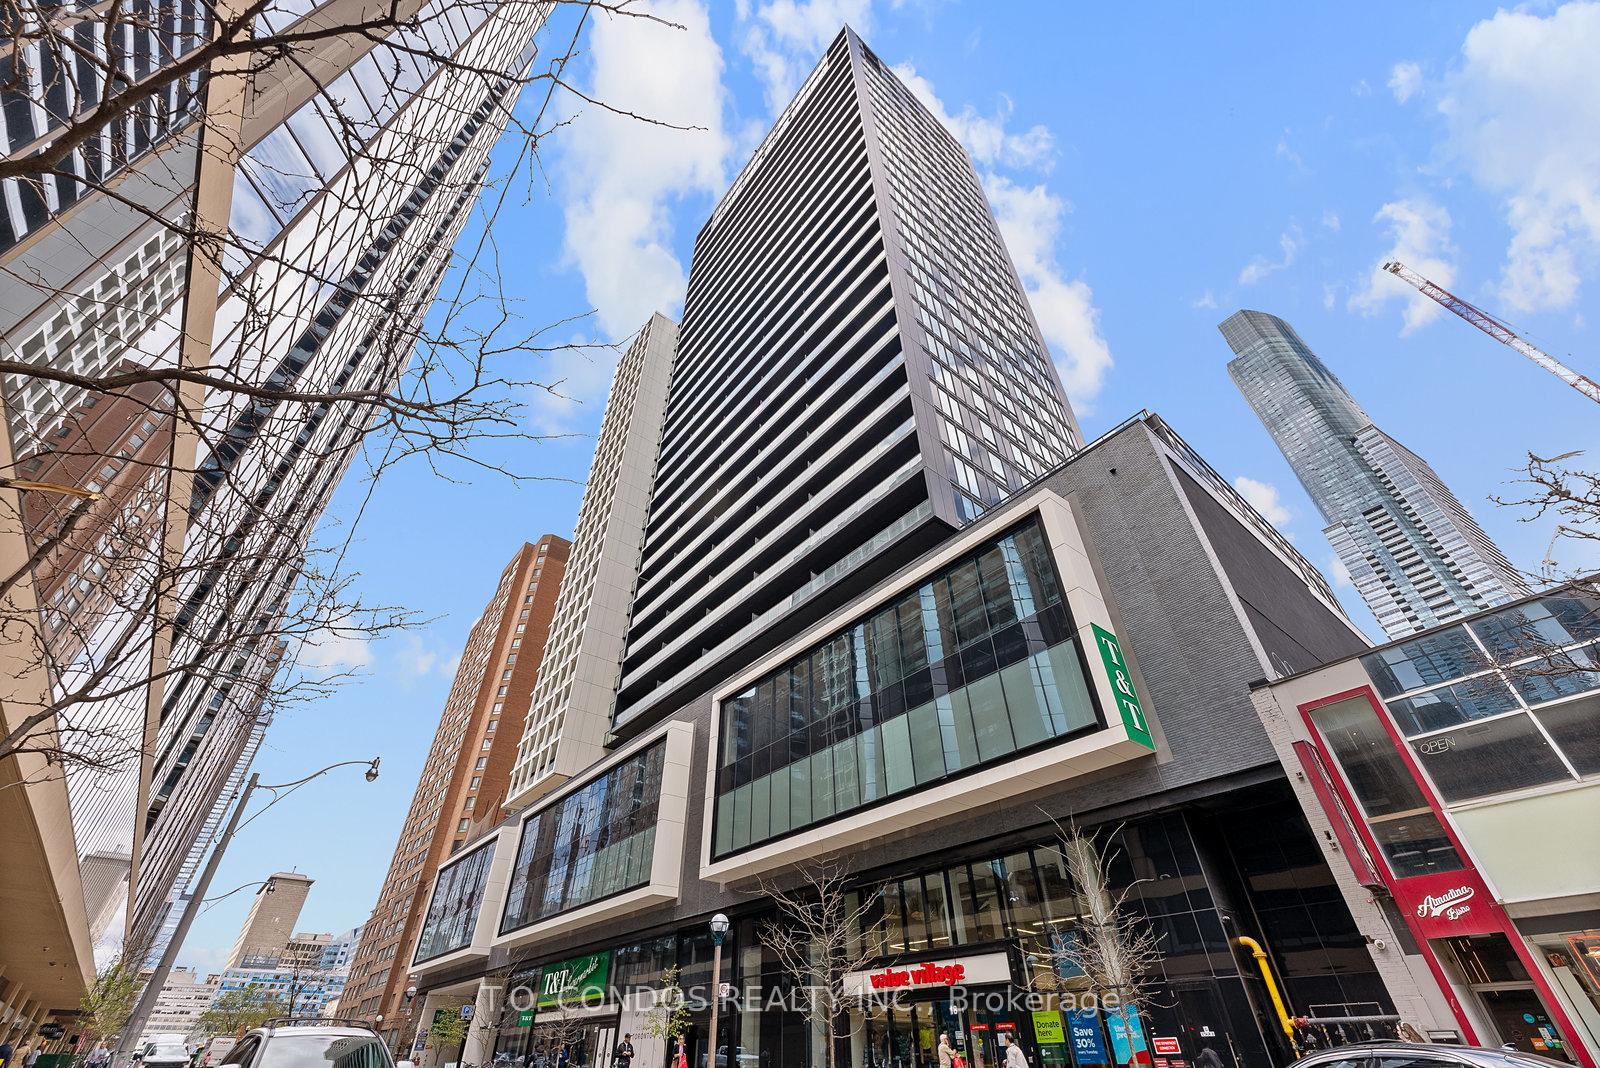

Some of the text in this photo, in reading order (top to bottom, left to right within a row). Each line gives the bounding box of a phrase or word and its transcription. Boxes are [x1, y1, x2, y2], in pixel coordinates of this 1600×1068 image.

[1101, 636, 1144, 732] T&T
[1420, 737, 1456, 753] OPEN
[1417, 885, 1475, 918] Almadina
[543, 969, 569, 995] T&T
[870, 962, 966, 989] value village
[1036, 1021, 1060, 1029] Donate
[1037, 1029, 1053, 1037] here
[1073, 1027, 1094, 1037] Save
[1075, 1038, 1096, 1048] 30%
